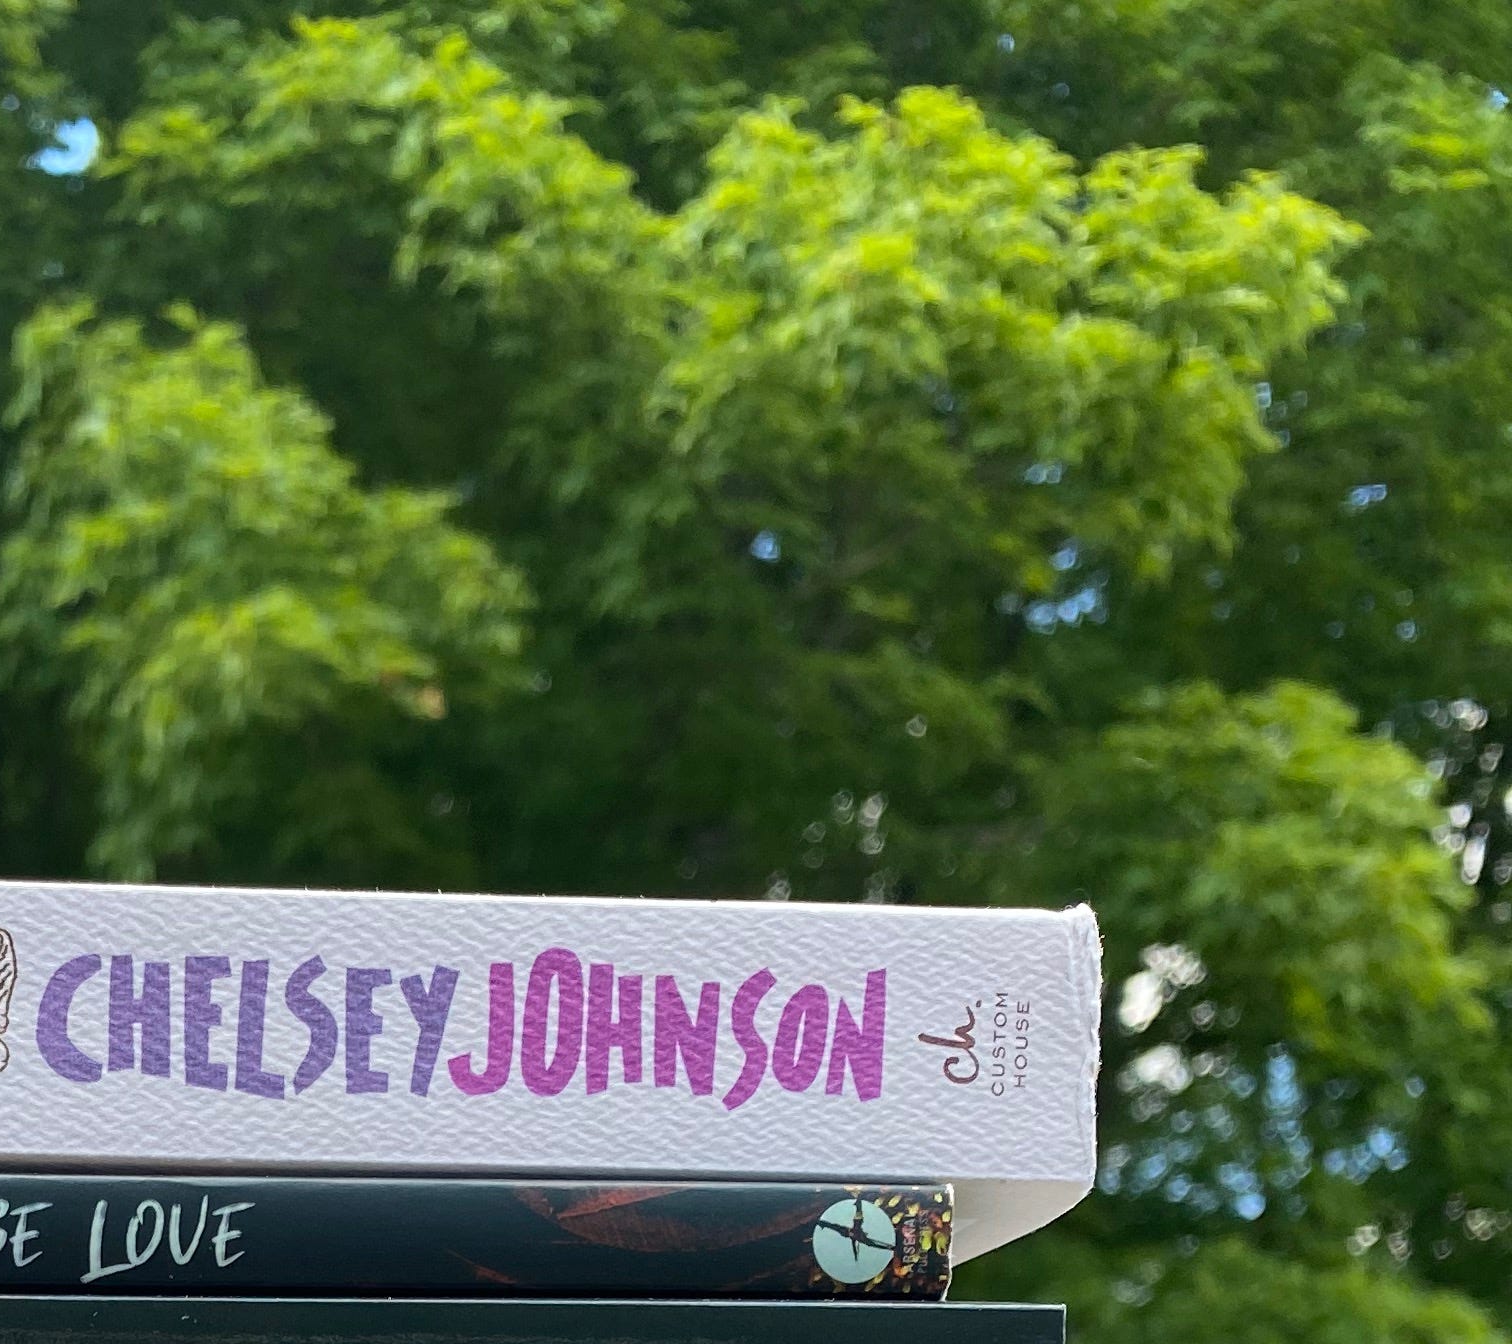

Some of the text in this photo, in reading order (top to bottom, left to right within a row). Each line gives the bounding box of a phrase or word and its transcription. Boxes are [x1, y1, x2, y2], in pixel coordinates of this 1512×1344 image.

[35, 947, 887, 1111] CHELSEY JOHNSON
[991, 992, 1008, 1096] CUSTOM
[1014, 1001, 1030, 1088] HOUSE
[80, 1195, 256, 1283] LOVE
